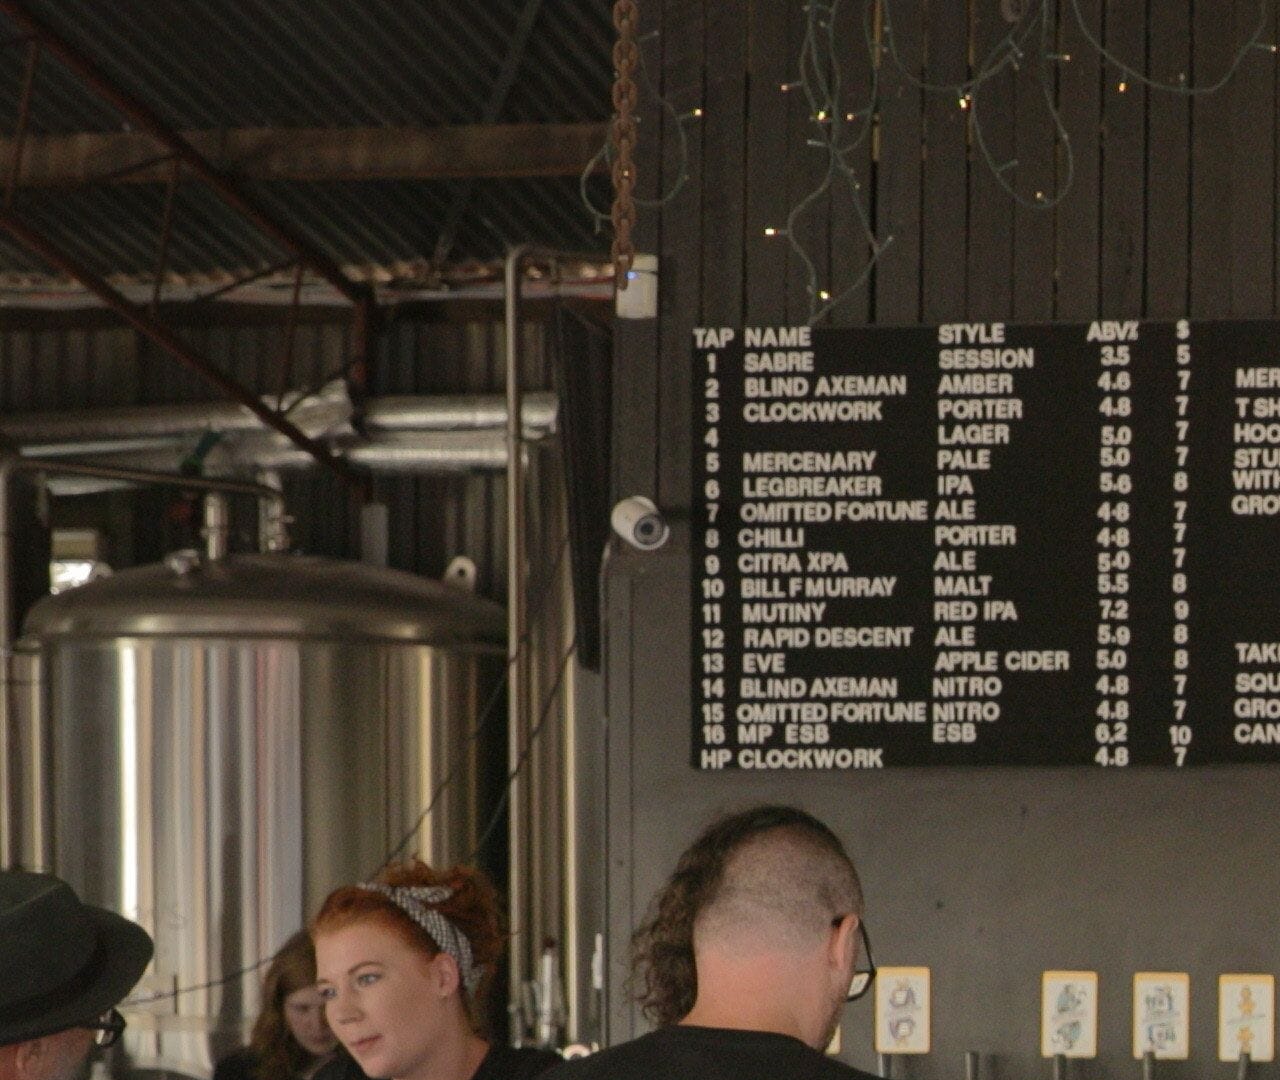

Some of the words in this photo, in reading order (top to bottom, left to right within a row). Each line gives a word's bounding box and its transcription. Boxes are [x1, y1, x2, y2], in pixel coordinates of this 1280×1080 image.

[693, 328, 734, 348] TAP
[745, 326, 811, 347] NAME
[939, 322, 1005, 344] STYLE
[744, 352, 814, 372] SABRE
[939, 348, 1034, 369] SESSION
[745, 377, 809, 398] BLIND
[815, 375, 906, 396] AXEMAN
[938, 373, 1013, 394] AMBER
[743, 401, 882, 422] CLOCKWORK
[938, 399, 1022, 419] PORTER
[1235, 397, 1250, 418] T
[938, 424, 1009, 445] LAGER
[743, 451, 876, 472] MERCENARY
[937, 449, 990, 470] PALE
[743, 476, 881, 497] LEGBREAKER
[938, 475, 973, 495] IPA
[741, 502, 832, 522] OMITTED
[835, 500, 927, 521] FORTUNE
[935, 500, 975, 520] ALE
[738, 528, 804, 548] CHILLI
[935, 525, 1016, 546] PORTER
[738, 553, 802, 573] CITRA
[807, 552, 848, 572] XPA
[934, 551, 976, 571] ALE
[741, 578, 785, 598] BILL
[805, 577, 896, 597] MURRAY
[934, 575, 992, 596] MALT
[743, 602, 826, 623] MUTINY
[934, 601, 978, 621] RED
[984, 601, 1017, 620] IPA
[744, 628, 810, 648] RAPID
[815, 627, 913, 647] DESCENT
[935, 626, 975, 646] ALE
[743, 653, 785, 673] EVE
[935, 651, 998, 671] APPLE
[1005, 650, 1069, 671] CIDER
[740, 678, 807, 698] BLIND
[810, 677, 897, 698] AXEMAN
[933, 676, 1002, 697] NITRO
[736, 703, 828, 725] OMITTED
[831, 702, 926, 722] FORTUNE
[933, 701, 1000, 724] NITRO
[738, 724, 773, 744] MP
[785, 723, 829, 744] ESB
[933, 721, 976, 743] ESB
[701, 749, 732, 769] HP
[738, 748, 883, 769] CLOCKWORK
